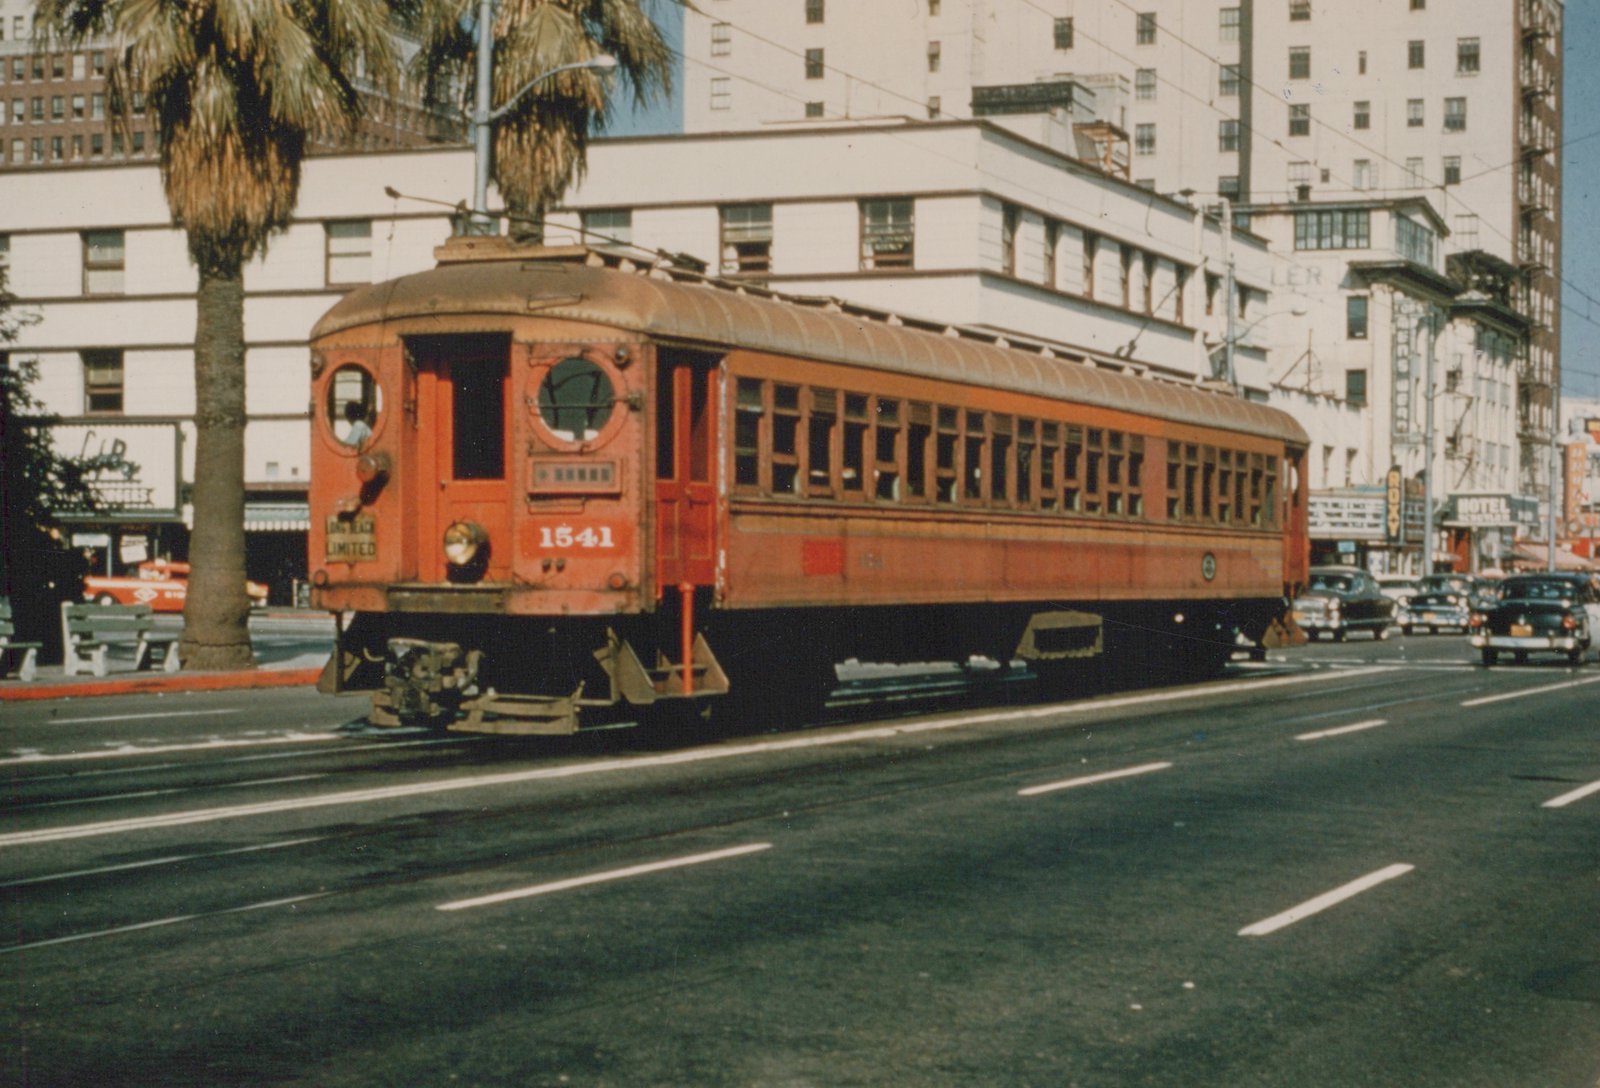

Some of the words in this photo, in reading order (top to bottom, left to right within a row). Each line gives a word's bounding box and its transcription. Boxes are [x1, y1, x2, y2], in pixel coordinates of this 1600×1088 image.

[1458, 497, 1510, 514] HOTEL
[539, 526, 615, 548] 1541
[325, 542, 376, 556] LIMITED
